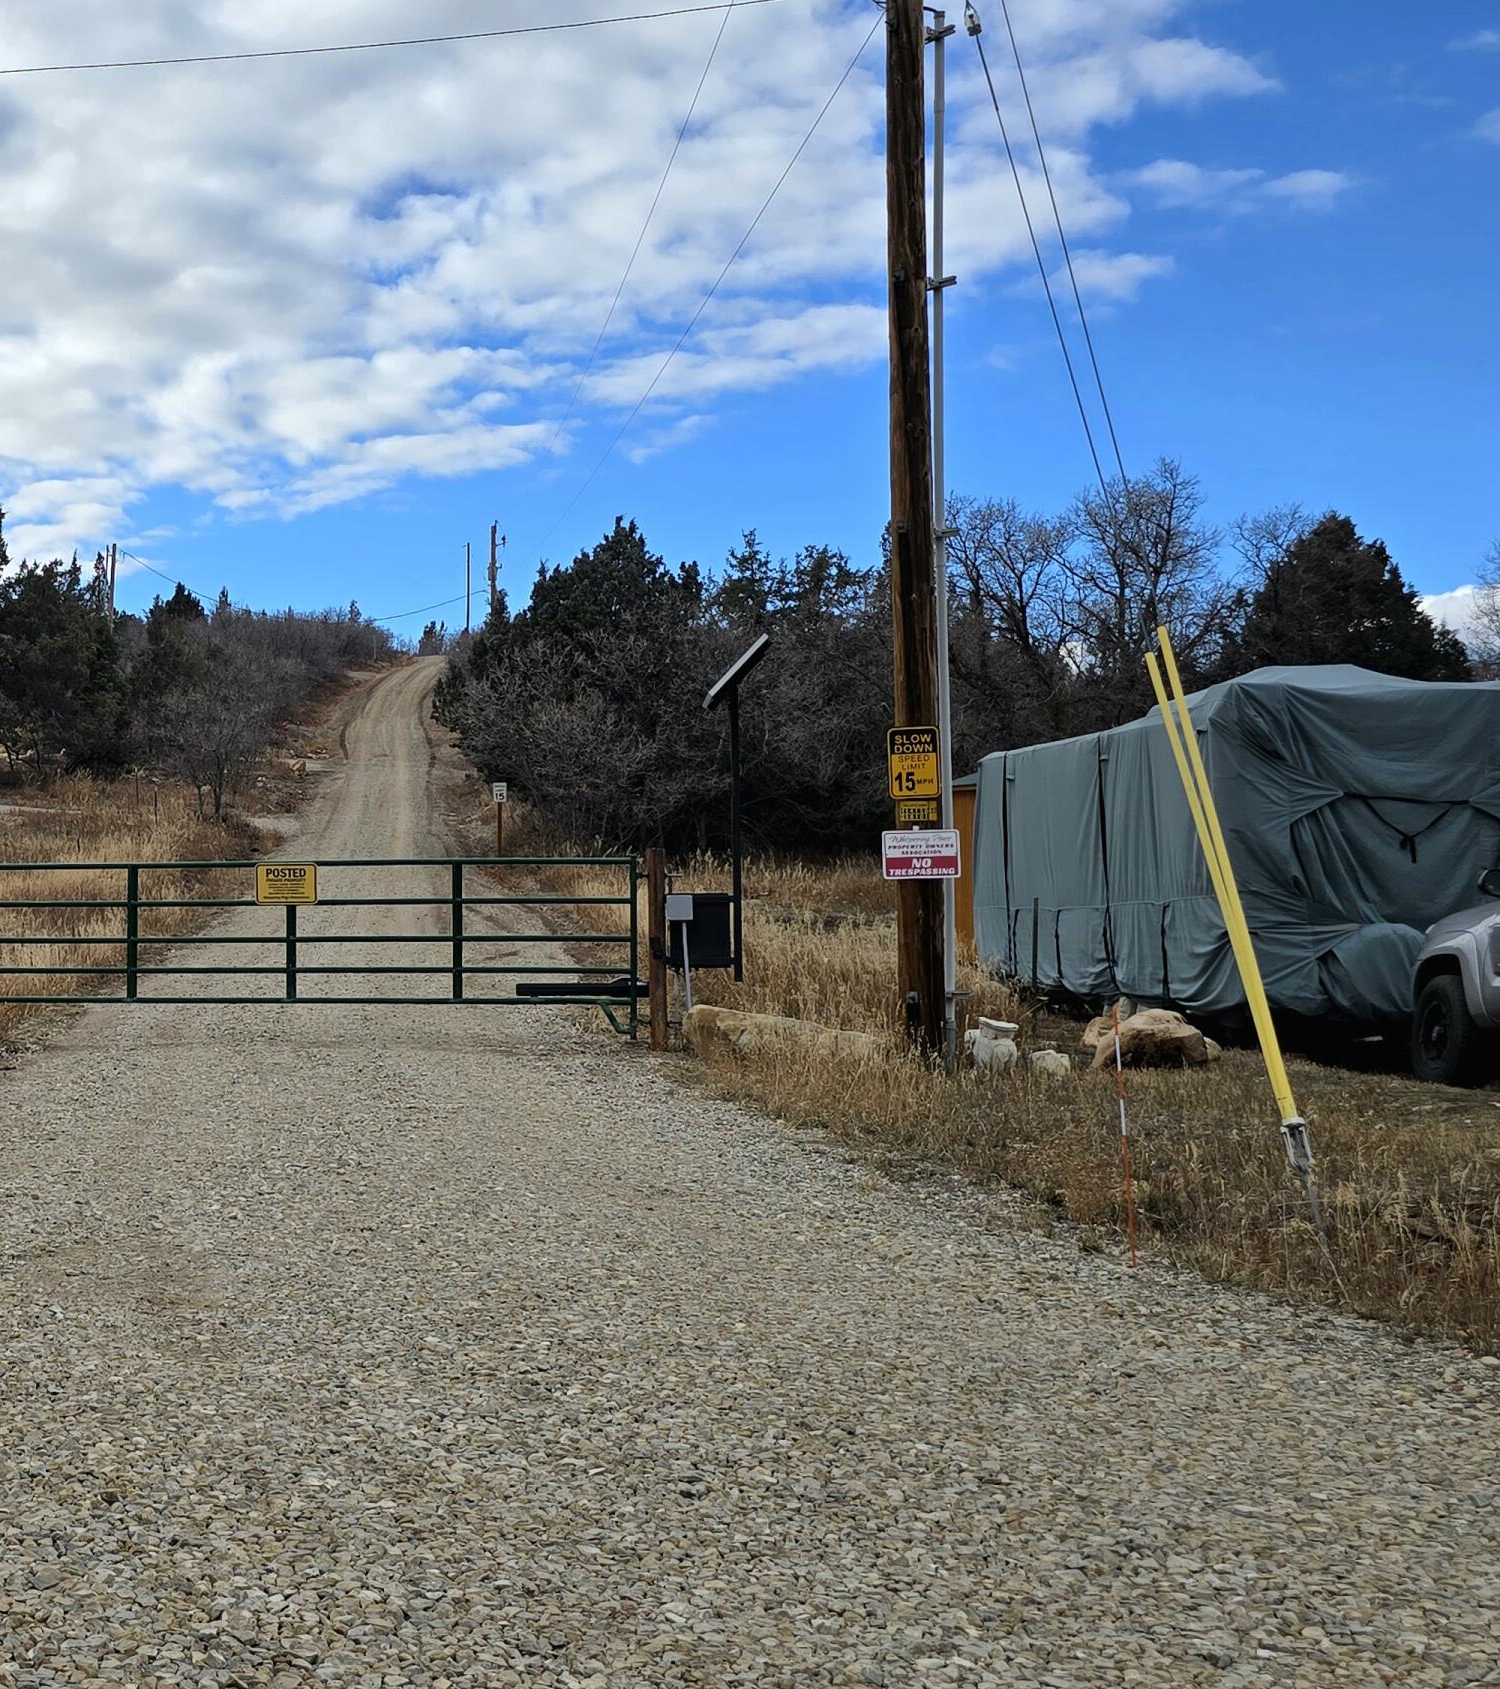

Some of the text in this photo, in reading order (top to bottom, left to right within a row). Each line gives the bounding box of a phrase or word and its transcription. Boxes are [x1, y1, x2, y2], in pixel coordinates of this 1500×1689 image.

[894, 734, 932, 744] SLOW
[894, 743, 933, 753] DOWN
[898, 754, 930, 763] SPEED
[894, 771, 916, 792] 15
[495, 792, 505, 801] 15
[912, 858, 932, 868] NO
[265, 868, 306, 878] POSTED
[888, 867, 956, 876] TRESPASSING
